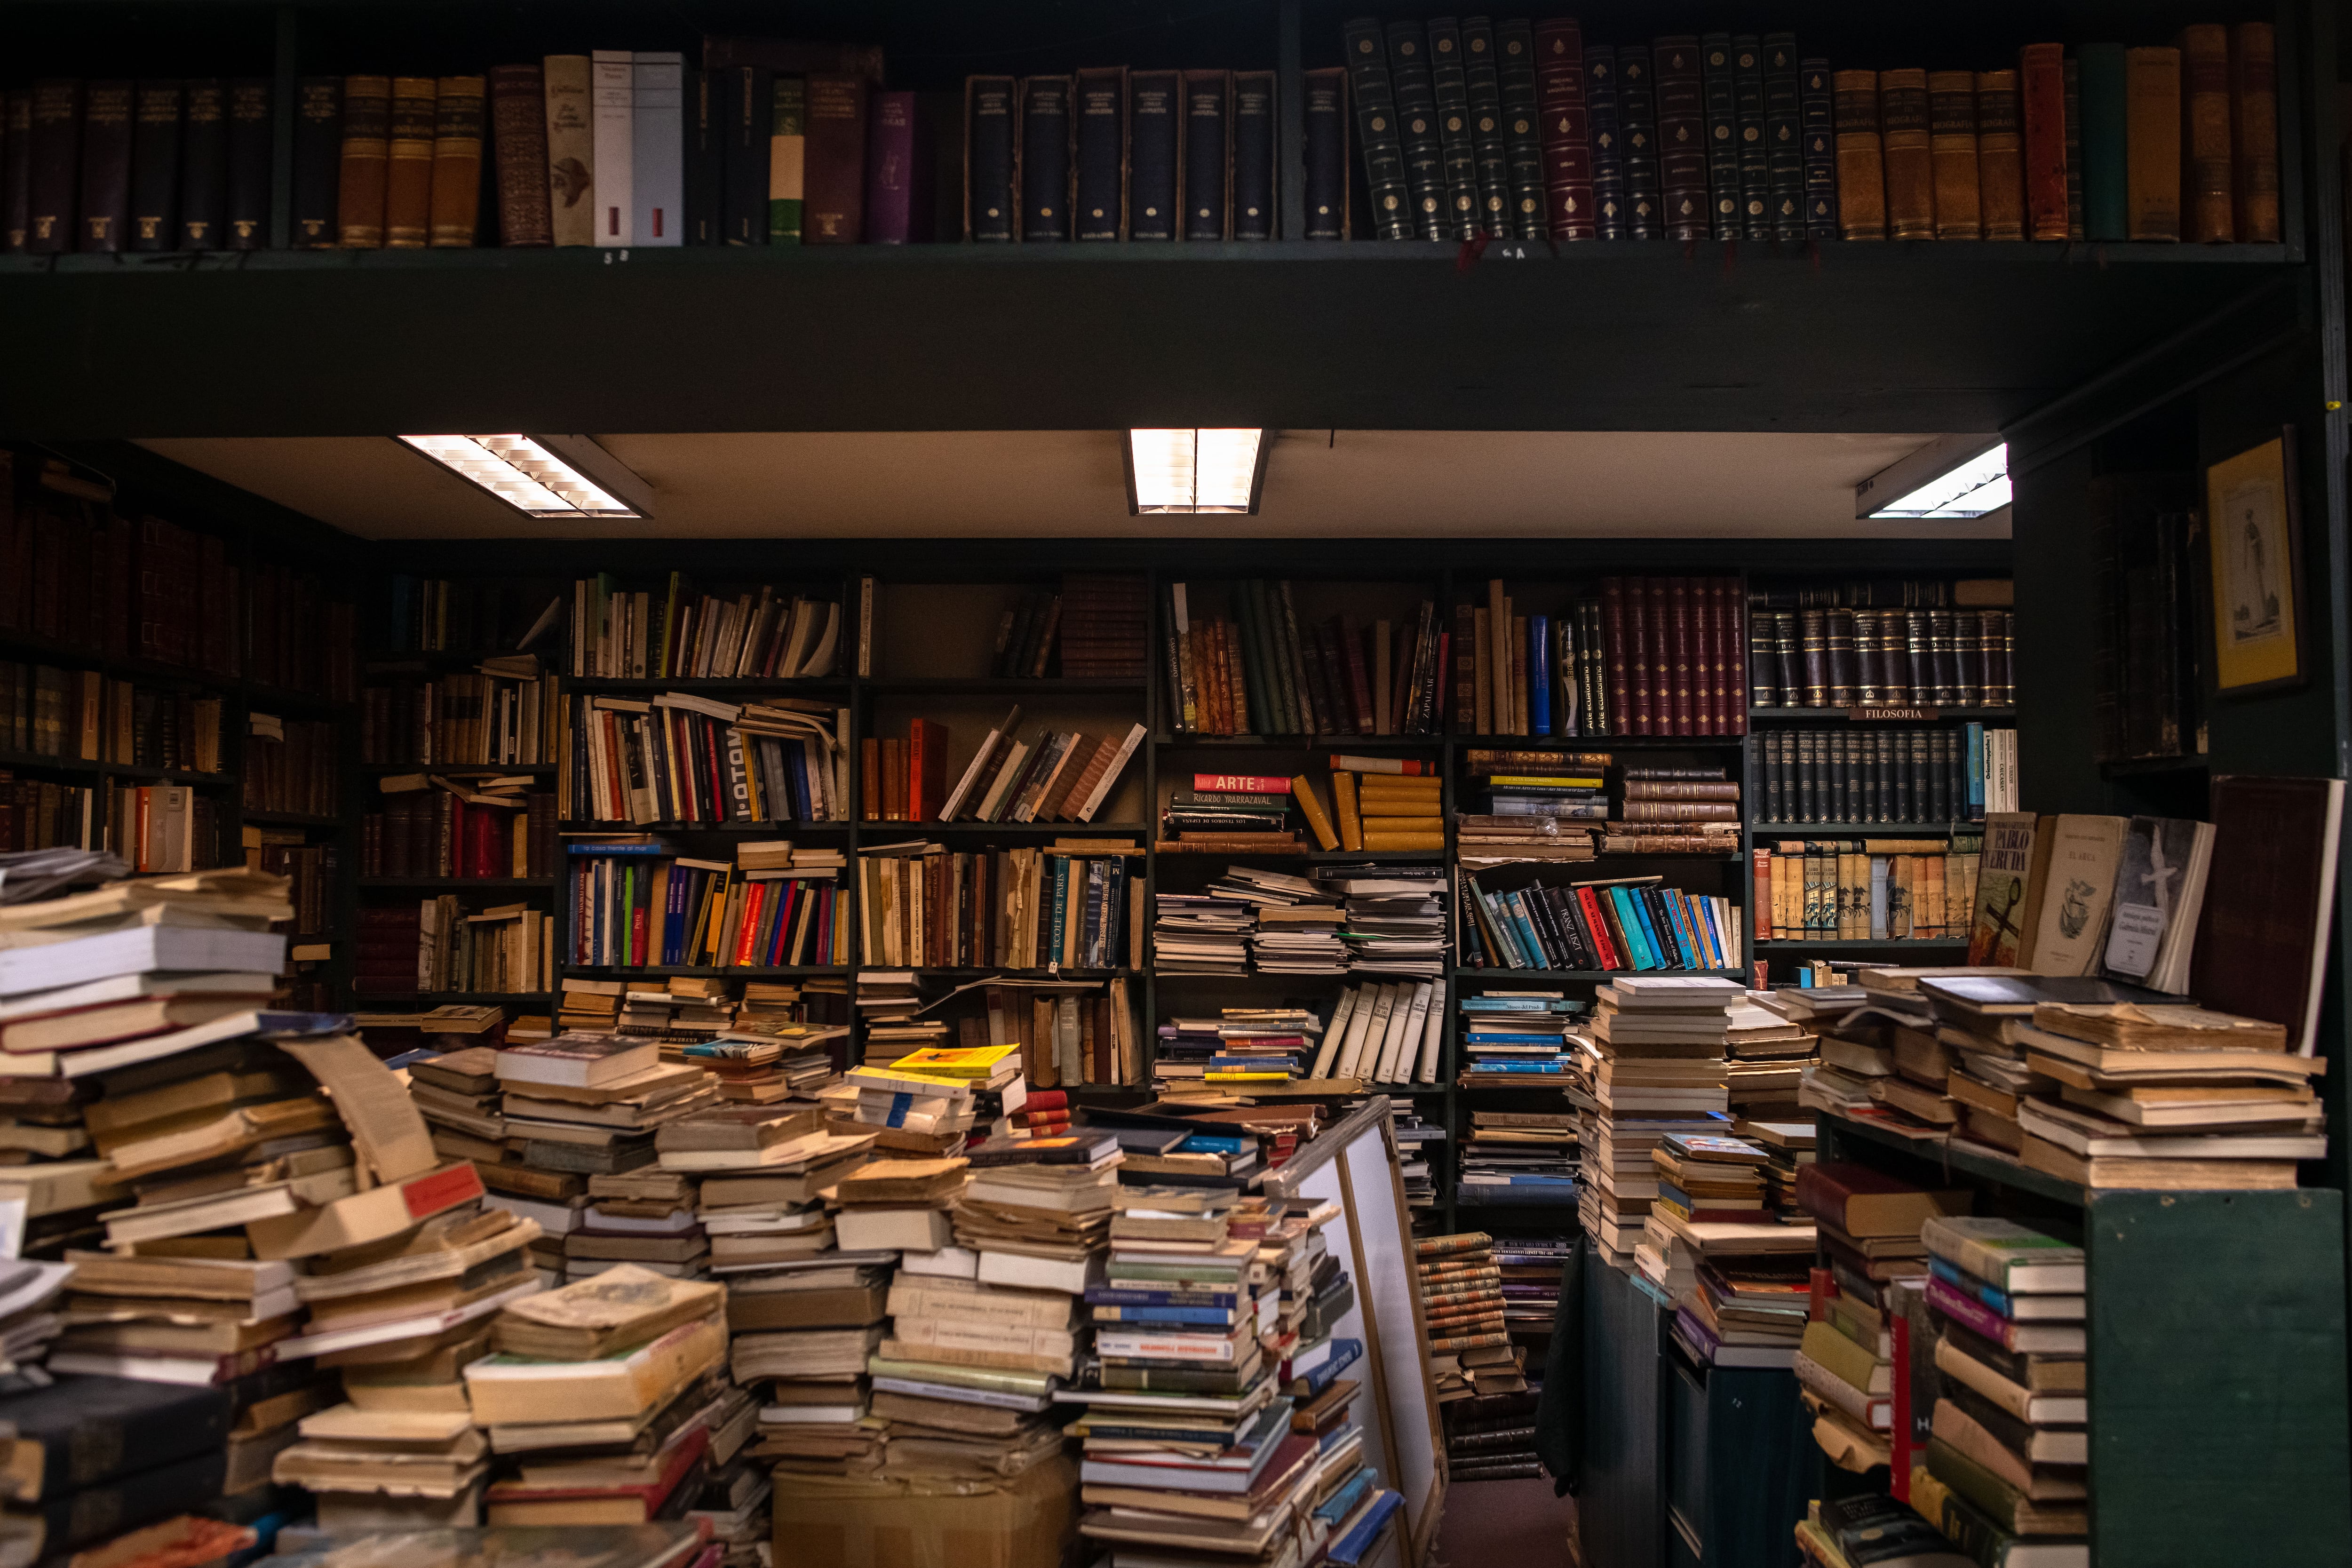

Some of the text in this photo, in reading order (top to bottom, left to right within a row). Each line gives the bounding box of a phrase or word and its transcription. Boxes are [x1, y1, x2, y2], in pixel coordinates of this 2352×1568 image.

[1422, 678, 1434, 718] ZAPALLAR
[1582, 666, 1592, 710] ecuatoriano
[1595, 666, 1604, 710] ecuatoriano
[1866, 710, 1922, 718] FILOSOFIA
[1216, 776, 1254, 790] ARTE
[1193, 793, 1271, 804] RICARDO YRARRAZAVAL
[1995, 829, 2029, 850] PABLO
[1981, 850, 2026, 871] NERUDA
[1560, 908, 1582, 951] FRANZ LISZT
